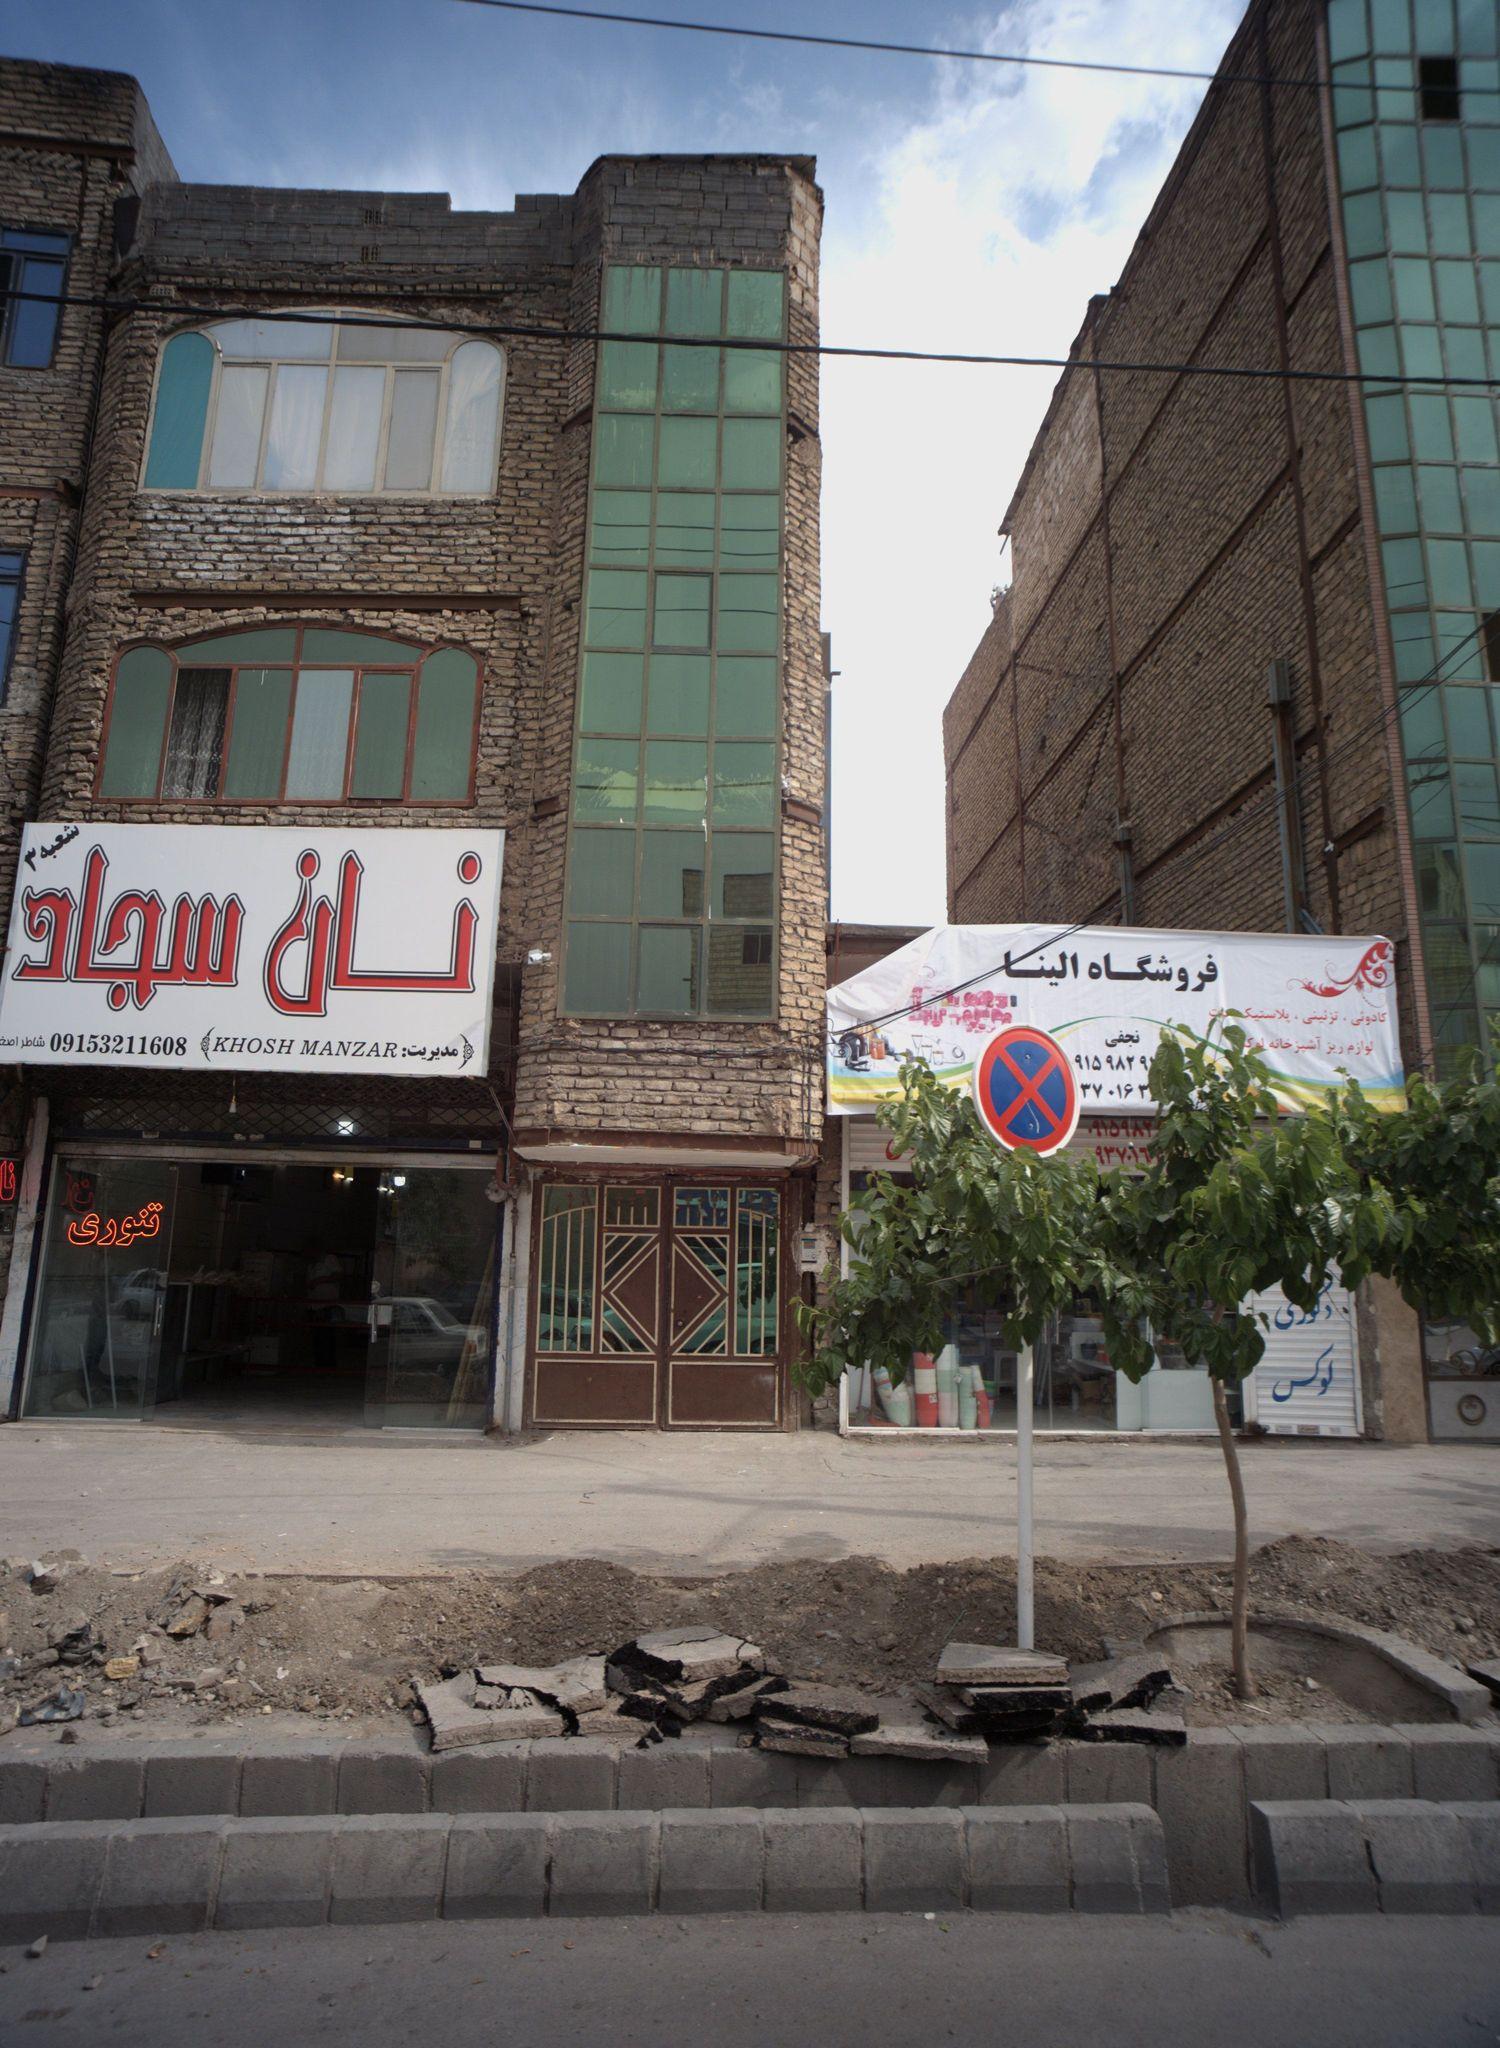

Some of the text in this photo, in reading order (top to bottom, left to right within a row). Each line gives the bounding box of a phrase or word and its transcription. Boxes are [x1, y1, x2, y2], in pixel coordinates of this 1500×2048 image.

[41, 825, 80, 859] شعبه
[12, 844, 482, 1016] نان سجاد
[1004, 950, 1218, 992] فروشگاه الینا
[21, 1035, 46, 1049] شاطر
[49, 1032, 188, 1056] 09153211608
[213, 1036, 398, 1059] KHOSH MANZAR
[1105, 1030, 1140, 1048] نجفی
[1347, 1040, 1374, 1056] لوازم
[401, 1044, 459, 1061] مدیریت:
[67, 1202, 163, 1246] تنوری
[1271, 1343, 1335, 1403] لوکس
